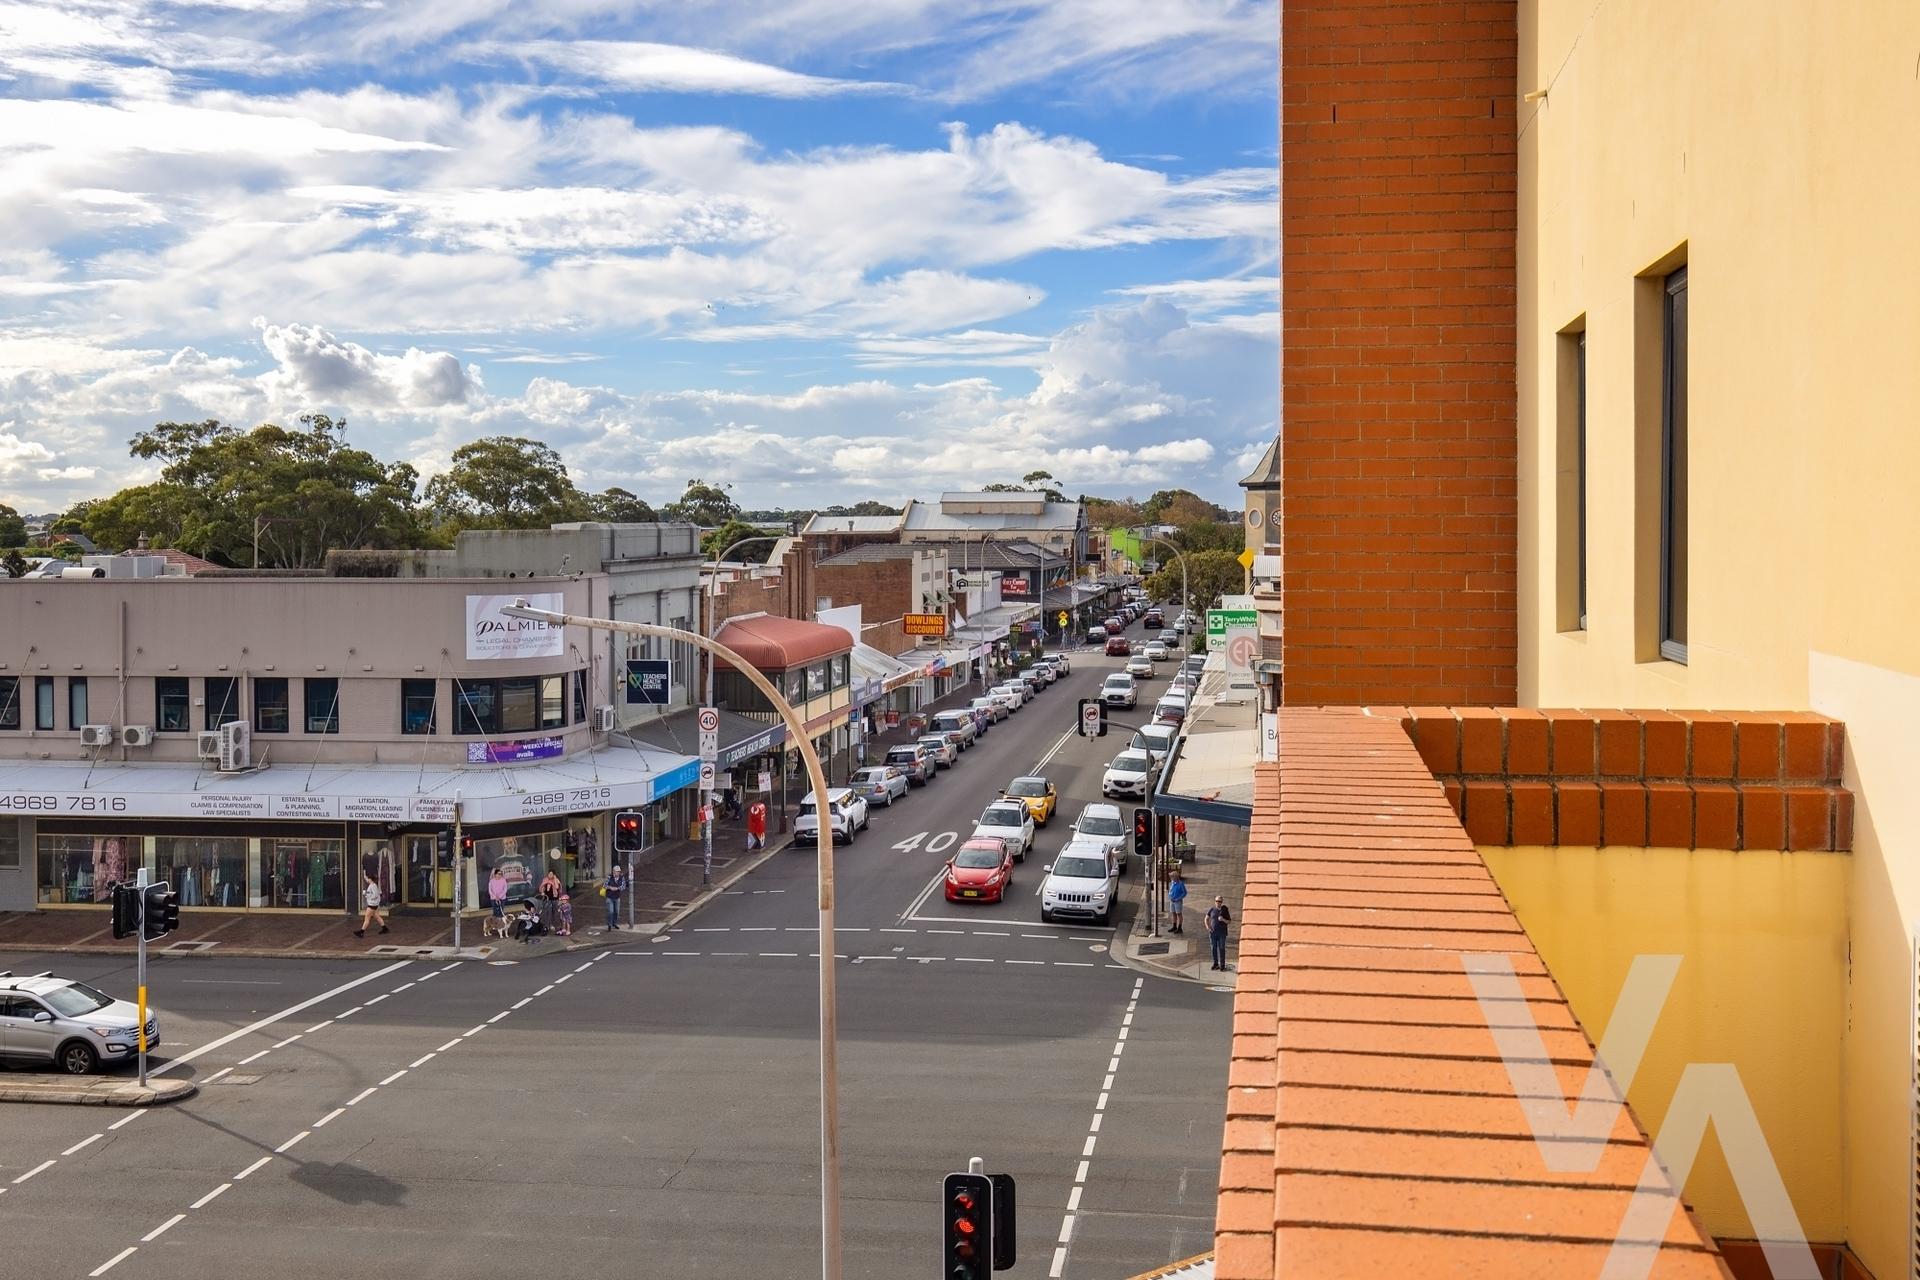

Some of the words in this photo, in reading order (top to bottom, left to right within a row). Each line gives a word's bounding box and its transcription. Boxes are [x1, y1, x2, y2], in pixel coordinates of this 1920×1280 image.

[906, 615, 944, 625] DOWLINGS
[906, 625, 944, 634] DISCOUNTS
[702, 716, 715, 726] 40
[522, 742, 544, 750] WEEKLY
[522, 792, 565, 806] 4969
[570, 788, 611, 801] 7816
[0, 796, 57, 810] 4969
[66, 796, 126, 811] 7816
[522, 800, 611, 816] PALMIERI.COM.AU
[355, 812, 400, 820] CONVEYANCING
[891, 831, 959, 853] 40
